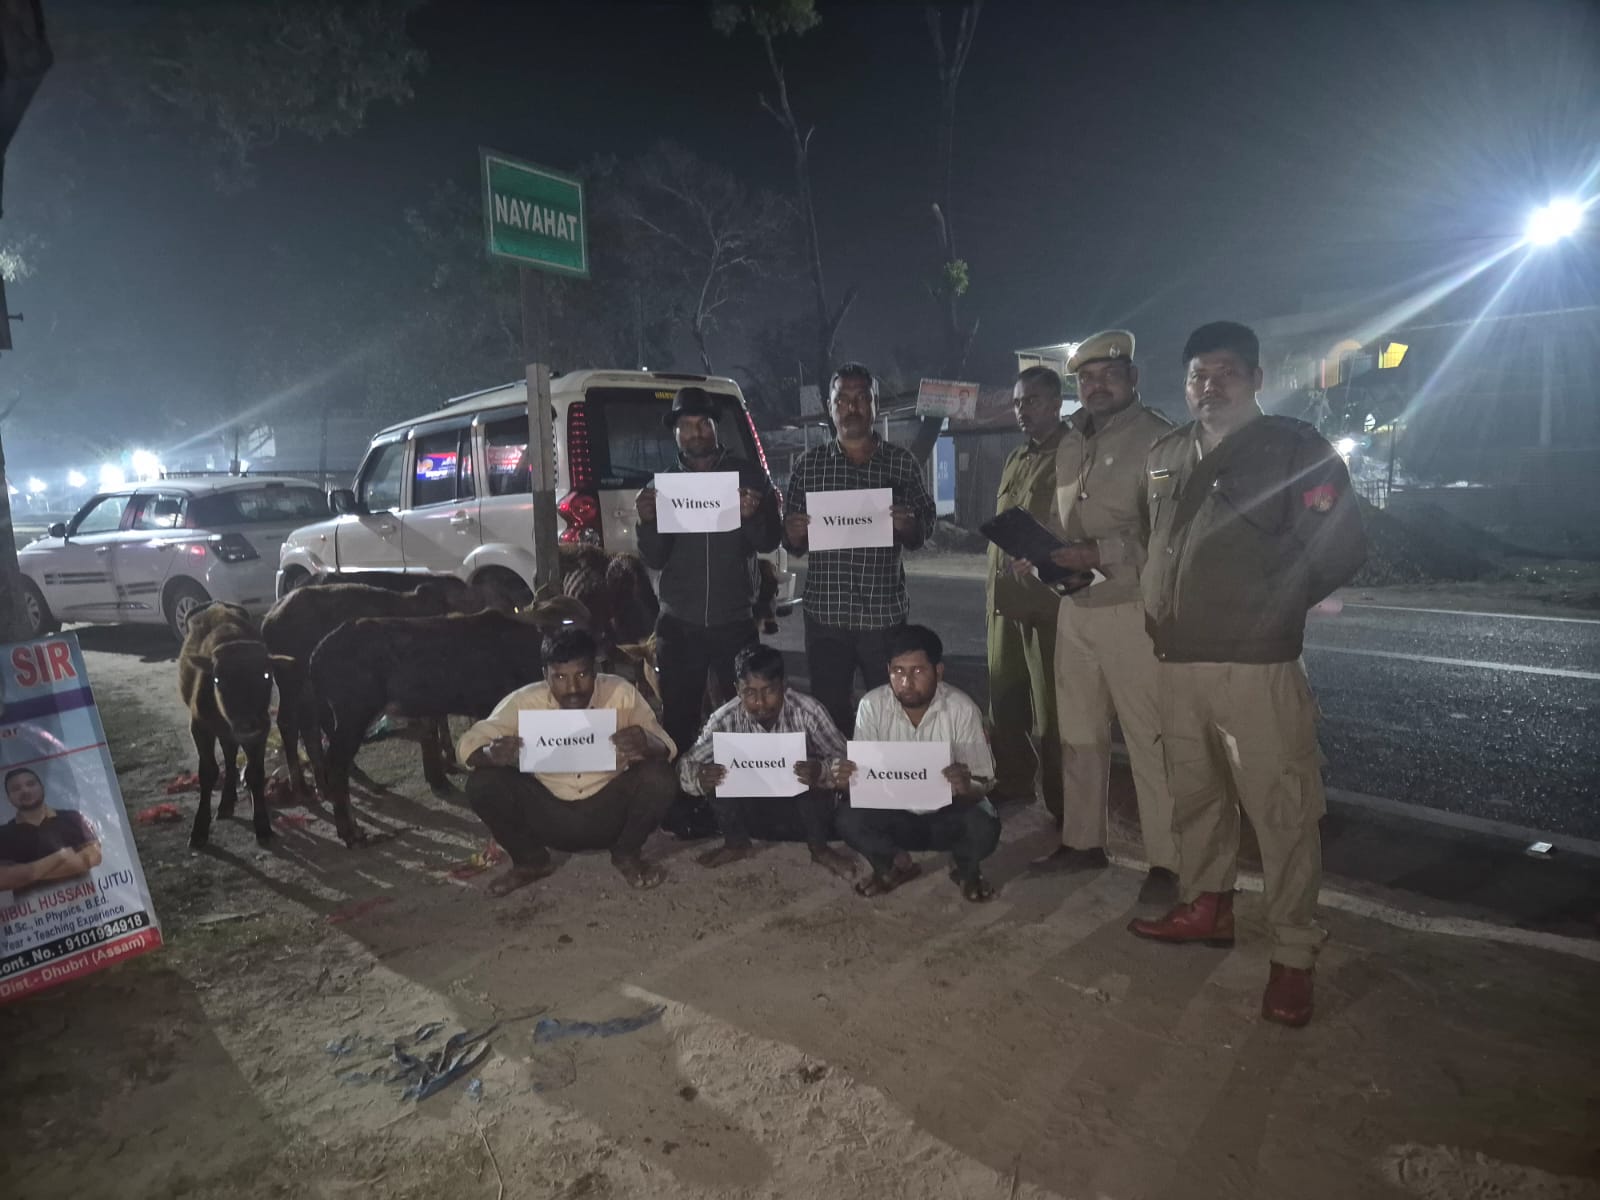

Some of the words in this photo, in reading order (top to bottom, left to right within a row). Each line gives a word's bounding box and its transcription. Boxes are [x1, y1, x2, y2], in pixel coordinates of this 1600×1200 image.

[494, 193, 578, 241] NAYAHAT
[671, 497, 721, 510] Witness
[822, 513, 874, 526] Witness
[11, 640, 77, 688] SIR
[535, 732, 596, 748] Accused
[729, 756, 787, 769] Accused
[866, 767, 928, 781] Accused
[39, 881, 97, 910] HUSSAIN
[98, 869, 134, 897] (JITU)
[33, 920, 75, 942] Teaching
[77, 904, 125, 928] Experience
[34, 915, 44, 927] in
[46, 904, 84, 923] Physics,
[85, 895, 109, 909] B.Ed.
[32, 949, 56, 963] No.
[66, 914, 143, 951] 9101934918
[41, 957, 89, 982] Dhubri
[92, 934, 146, 965] (Assam)
